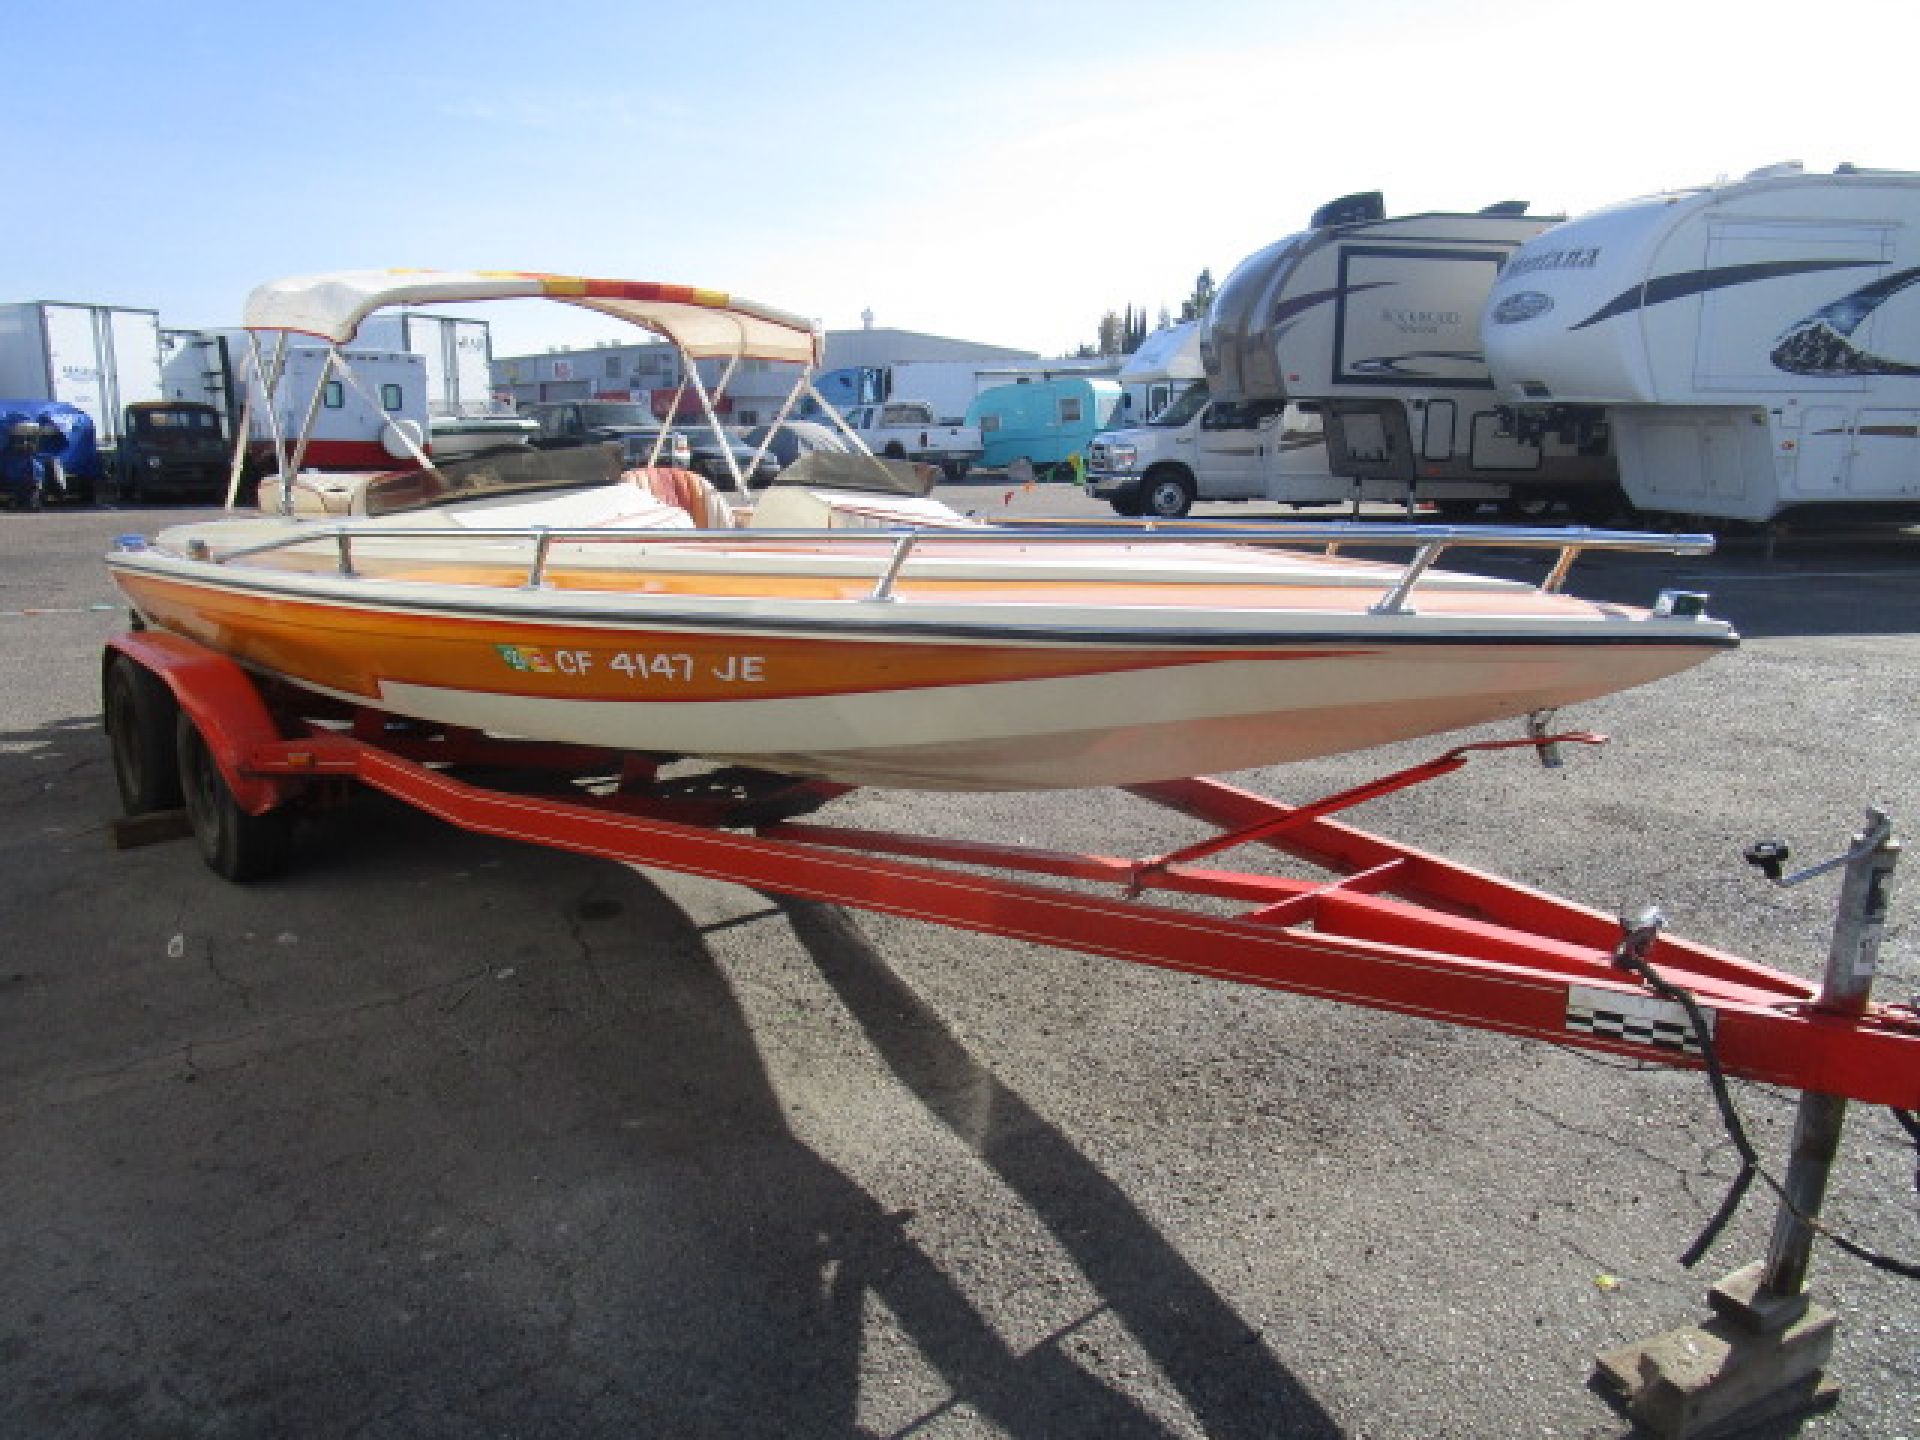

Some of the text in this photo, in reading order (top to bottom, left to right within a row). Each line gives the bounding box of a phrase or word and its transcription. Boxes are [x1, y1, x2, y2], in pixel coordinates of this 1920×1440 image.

[555, 650, 592, 675] CF
[609, 653, 693, 681] 4147
[711, 656, 766, 682] JE
